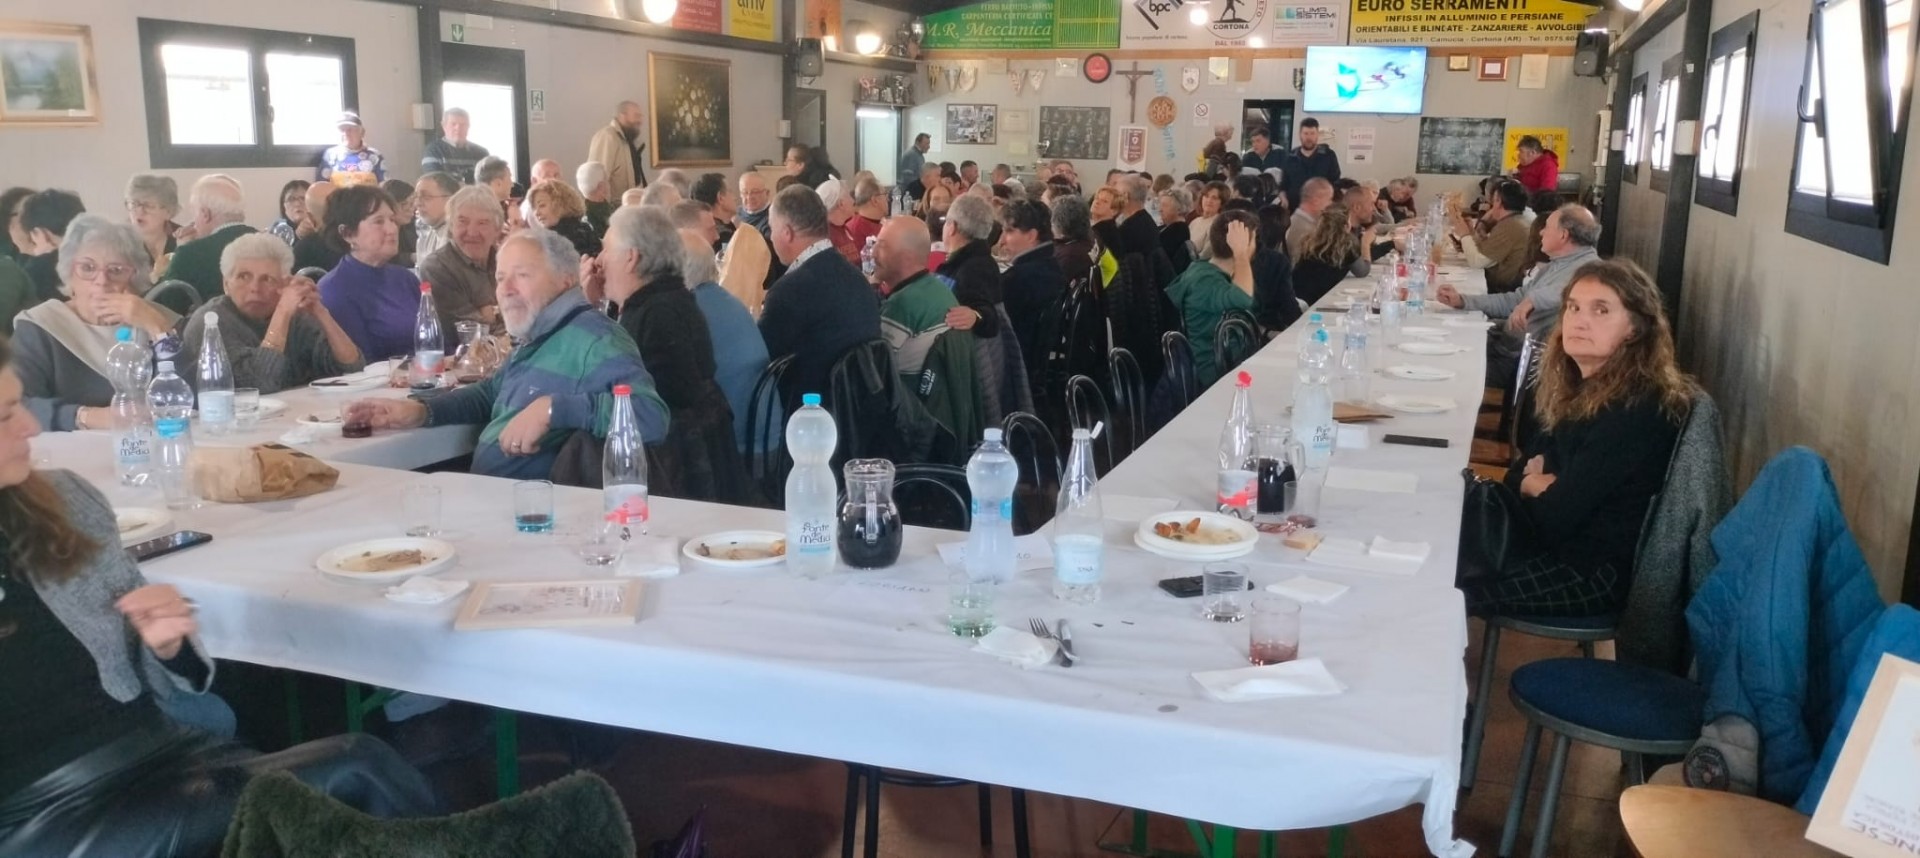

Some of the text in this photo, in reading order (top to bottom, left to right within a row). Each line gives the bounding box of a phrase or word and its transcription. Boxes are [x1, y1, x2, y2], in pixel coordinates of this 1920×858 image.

[1148, 0, 1171, 16] bpc
[1357, 0, 1528, 12] EURO SERRAMENTI
[1385, 14, 1422, 22] INFISSI
[1439, 13, 1497, 21] ALLUMINIO
[1510, 12, 1564, 20] PERSIANE
[965, 22, 1051, 36] Meccanica
[1355, 25, 1410, 33] ORIENTABILI
[1412, 24, 1418, 32] E
[1471, 24, 1528, 32] ZANZARIERE
